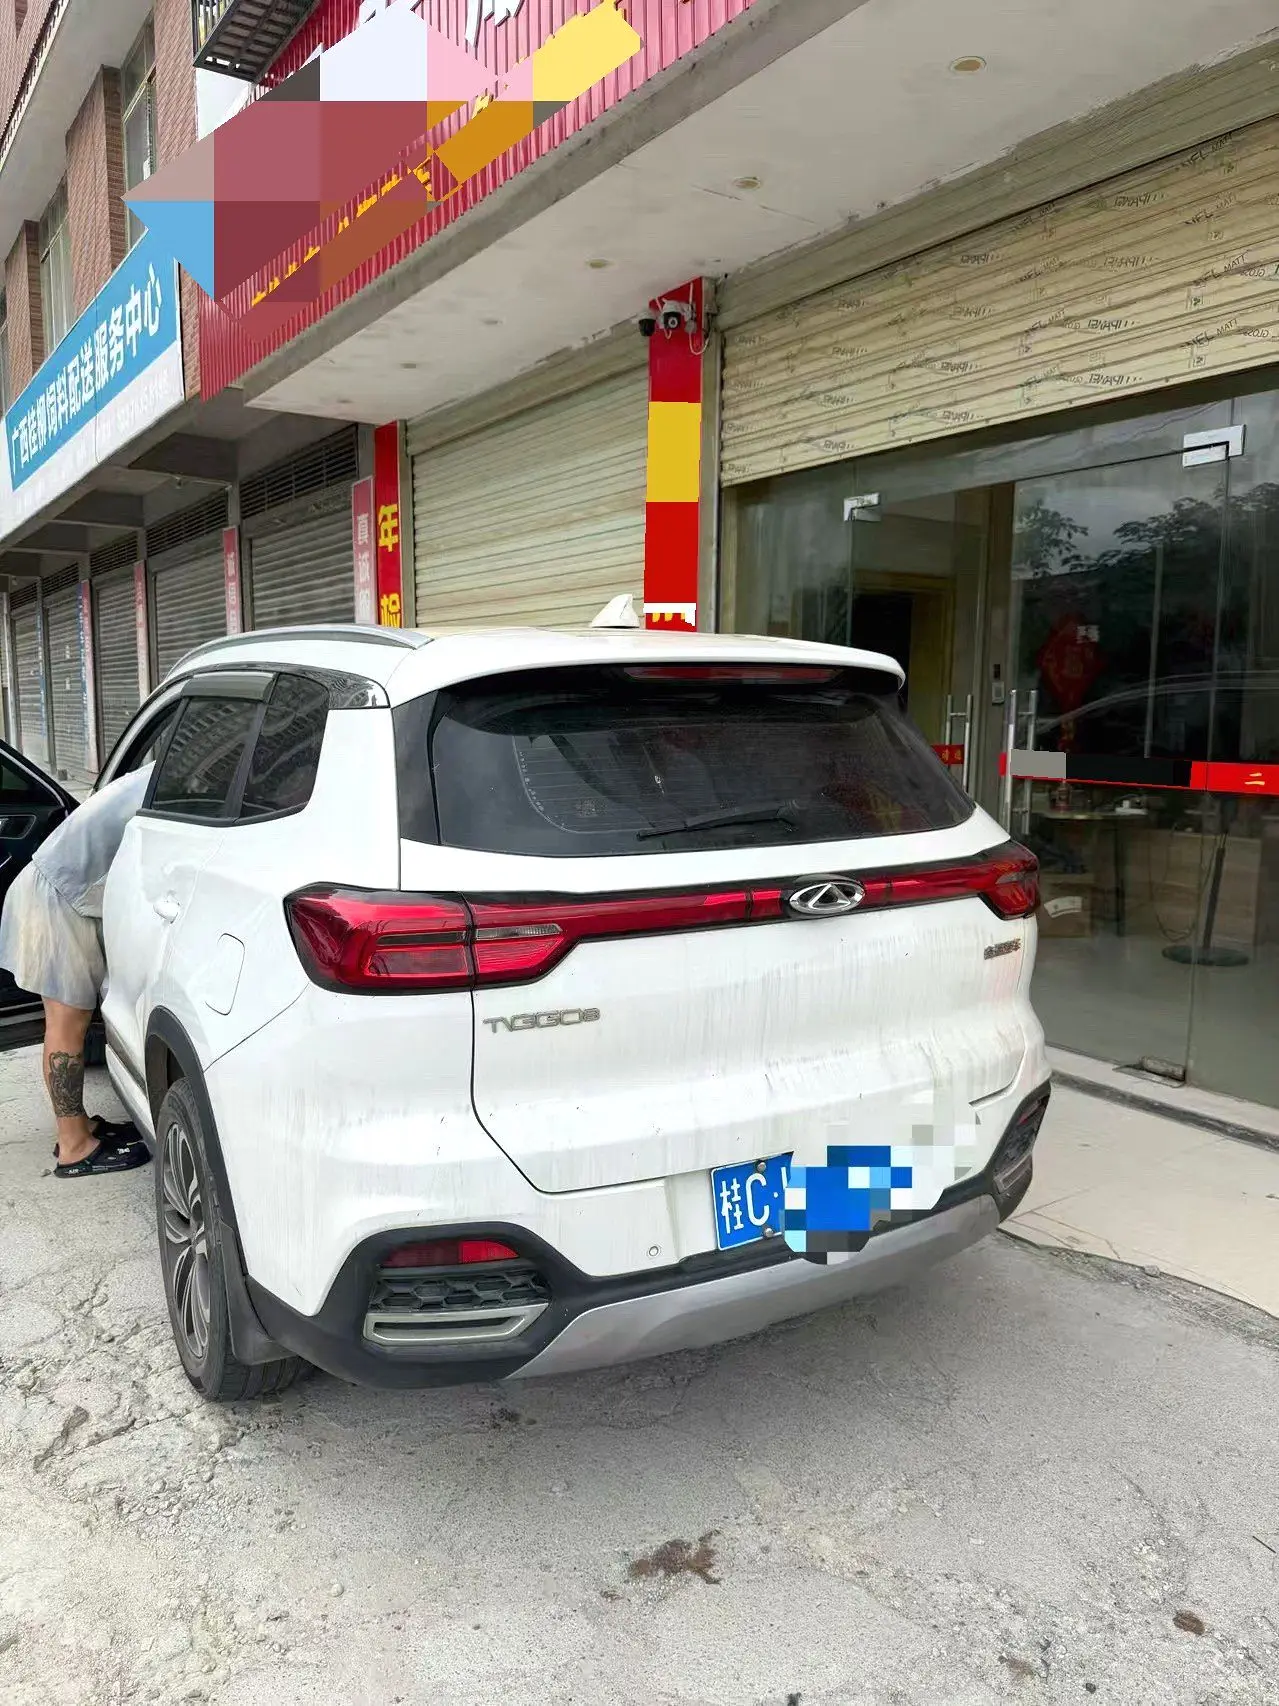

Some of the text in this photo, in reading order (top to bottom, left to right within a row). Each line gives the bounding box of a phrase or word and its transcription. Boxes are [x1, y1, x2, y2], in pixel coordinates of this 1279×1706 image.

[11, 261, 162, 476] 广西桂柳饲料配送服务中心
